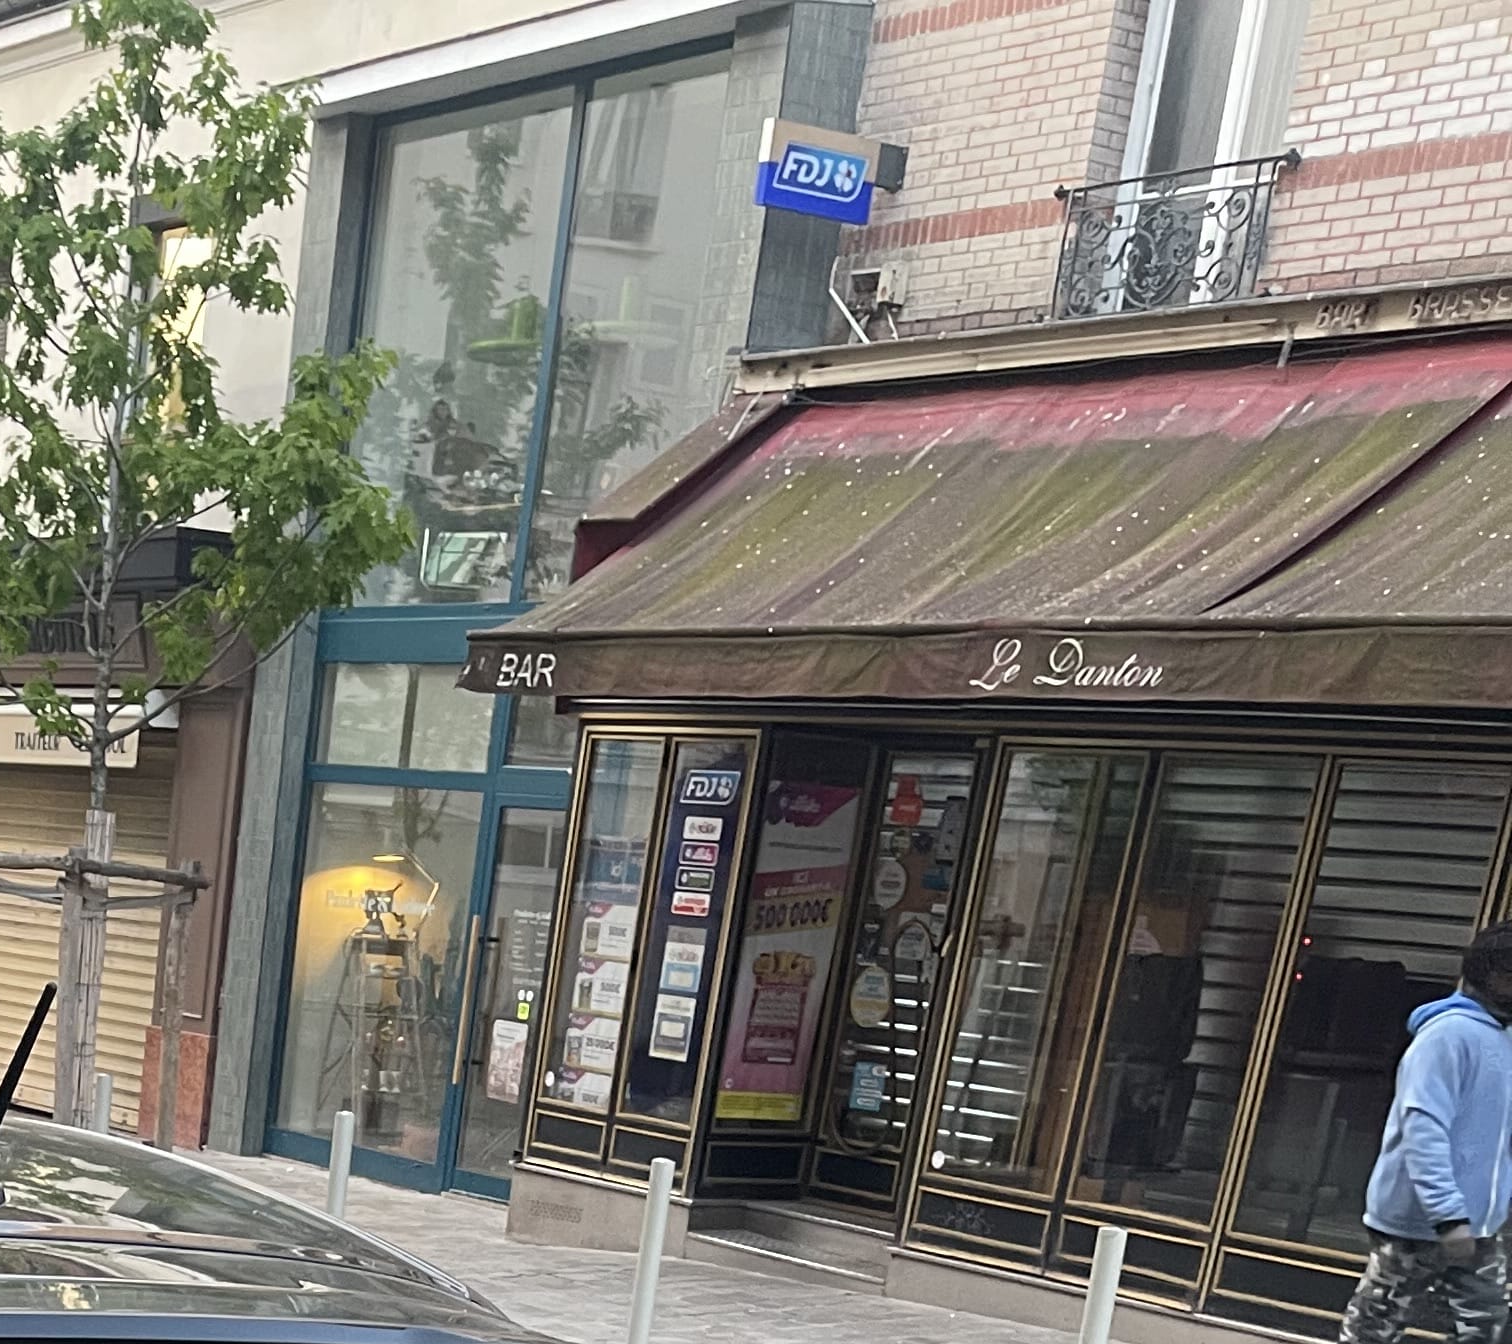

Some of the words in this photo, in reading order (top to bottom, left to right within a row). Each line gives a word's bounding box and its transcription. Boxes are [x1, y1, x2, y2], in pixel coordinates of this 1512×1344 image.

[782, 151, 834, 187] FDJ
[496, 653, 557, 688] BAR
[968, 638, 1022, 691] Le
[1032, 638, 1163, 687] Danton
[686, 776, 718, 797] FDJ
